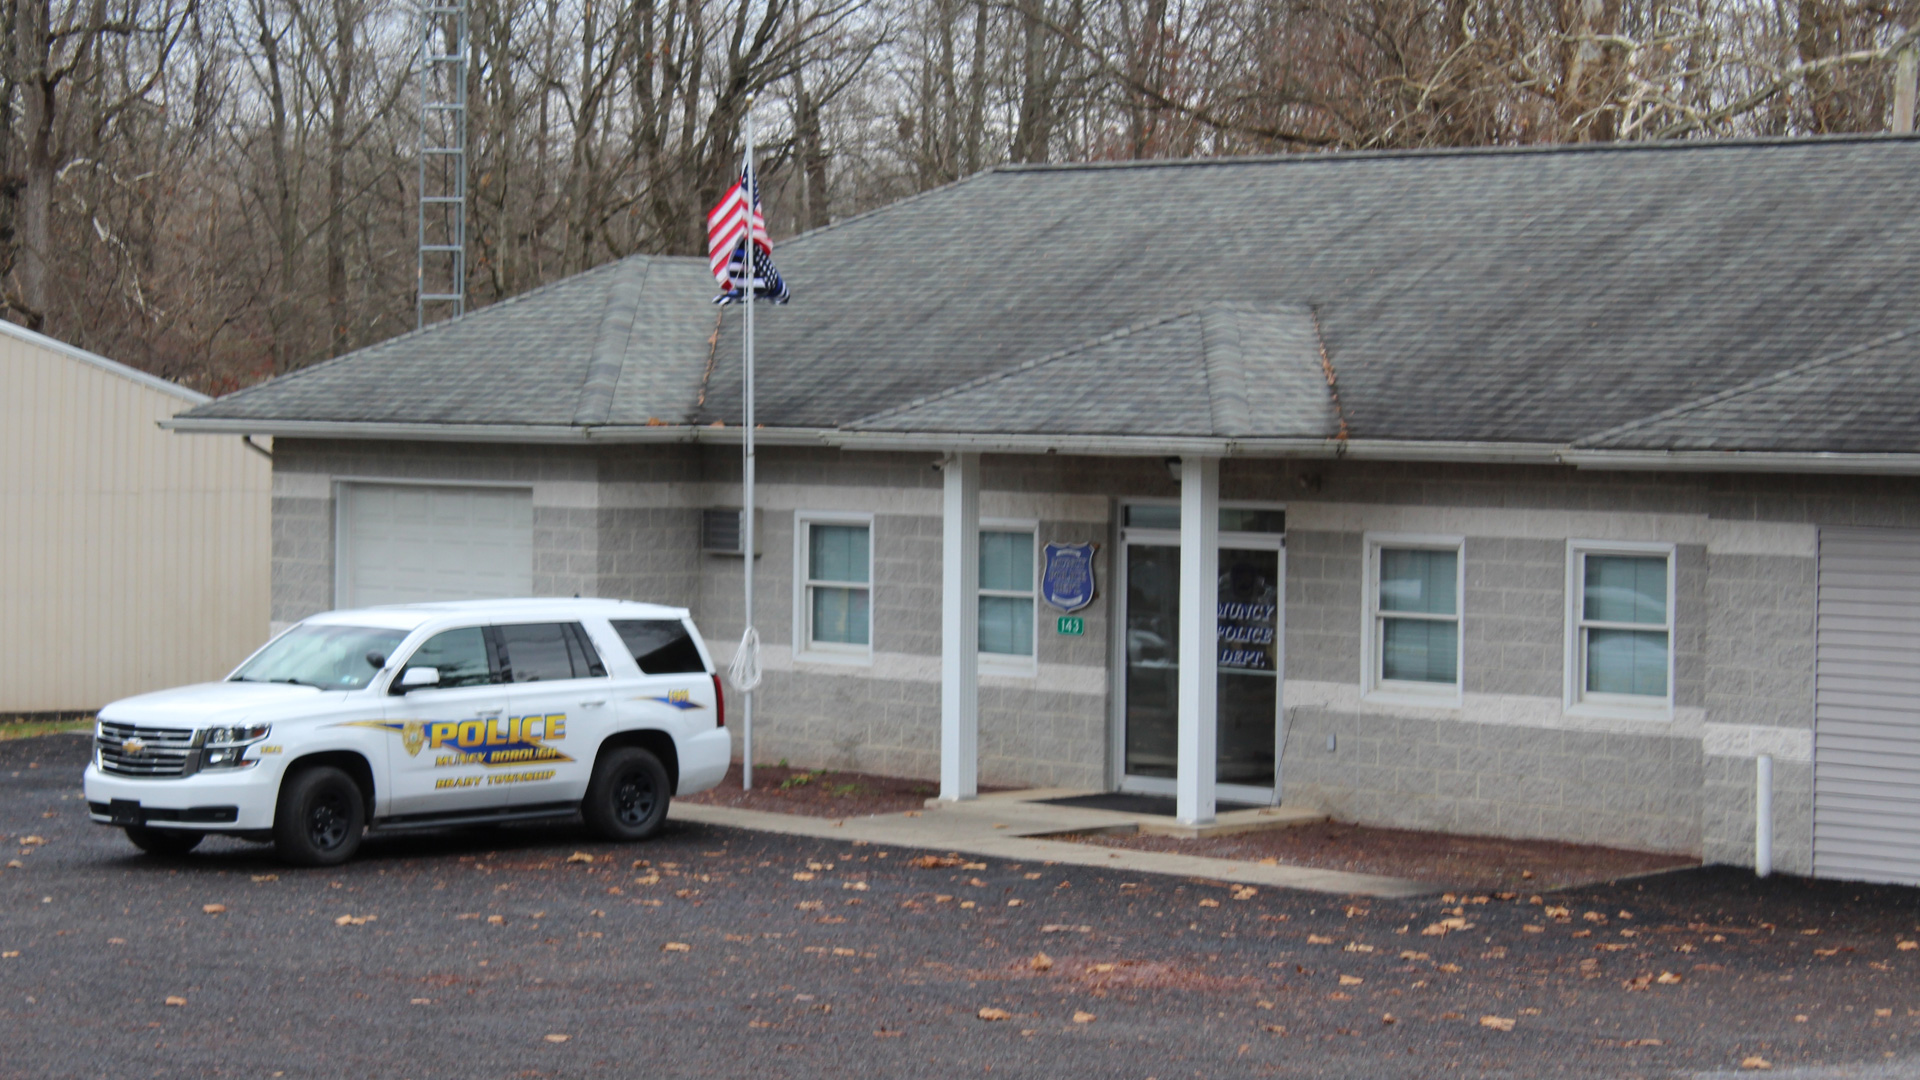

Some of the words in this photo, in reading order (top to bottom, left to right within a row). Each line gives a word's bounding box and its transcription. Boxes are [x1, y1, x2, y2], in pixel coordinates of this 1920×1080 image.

[1218, 602, 1275, 621] MUNCY
[1061, 618, 1080, 632] 143
[1218, 625, 1274, 644] POLICE
[1219, 649, 1265, 668] DEPT.
[429, 712, 567, 749] POLICE
[490, 747, 557, 763] BOROUGH
[487, 770, 556, 786] TOWNSHIP
